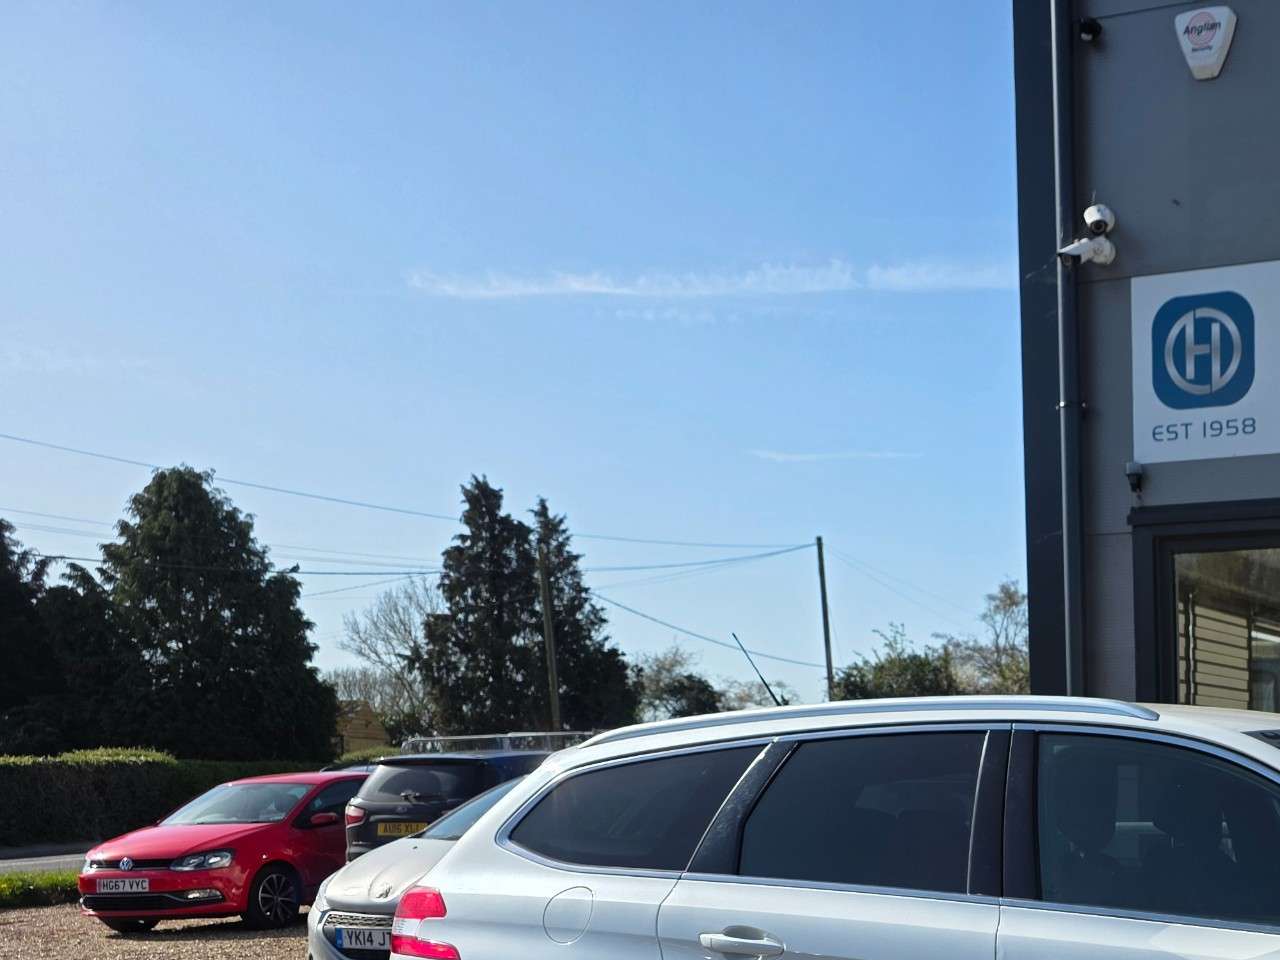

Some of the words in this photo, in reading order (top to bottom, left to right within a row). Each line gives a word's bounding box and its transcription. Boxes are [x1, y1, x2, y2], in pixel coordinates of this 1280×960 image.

[1152, 422, 1193, 442] EST
[1202, 417, 1256, 438] 1958
[102, 879, 126, 891] HG67
[128, 879, 147, 890] VYC
[346, 930, 374, 946] YK14
